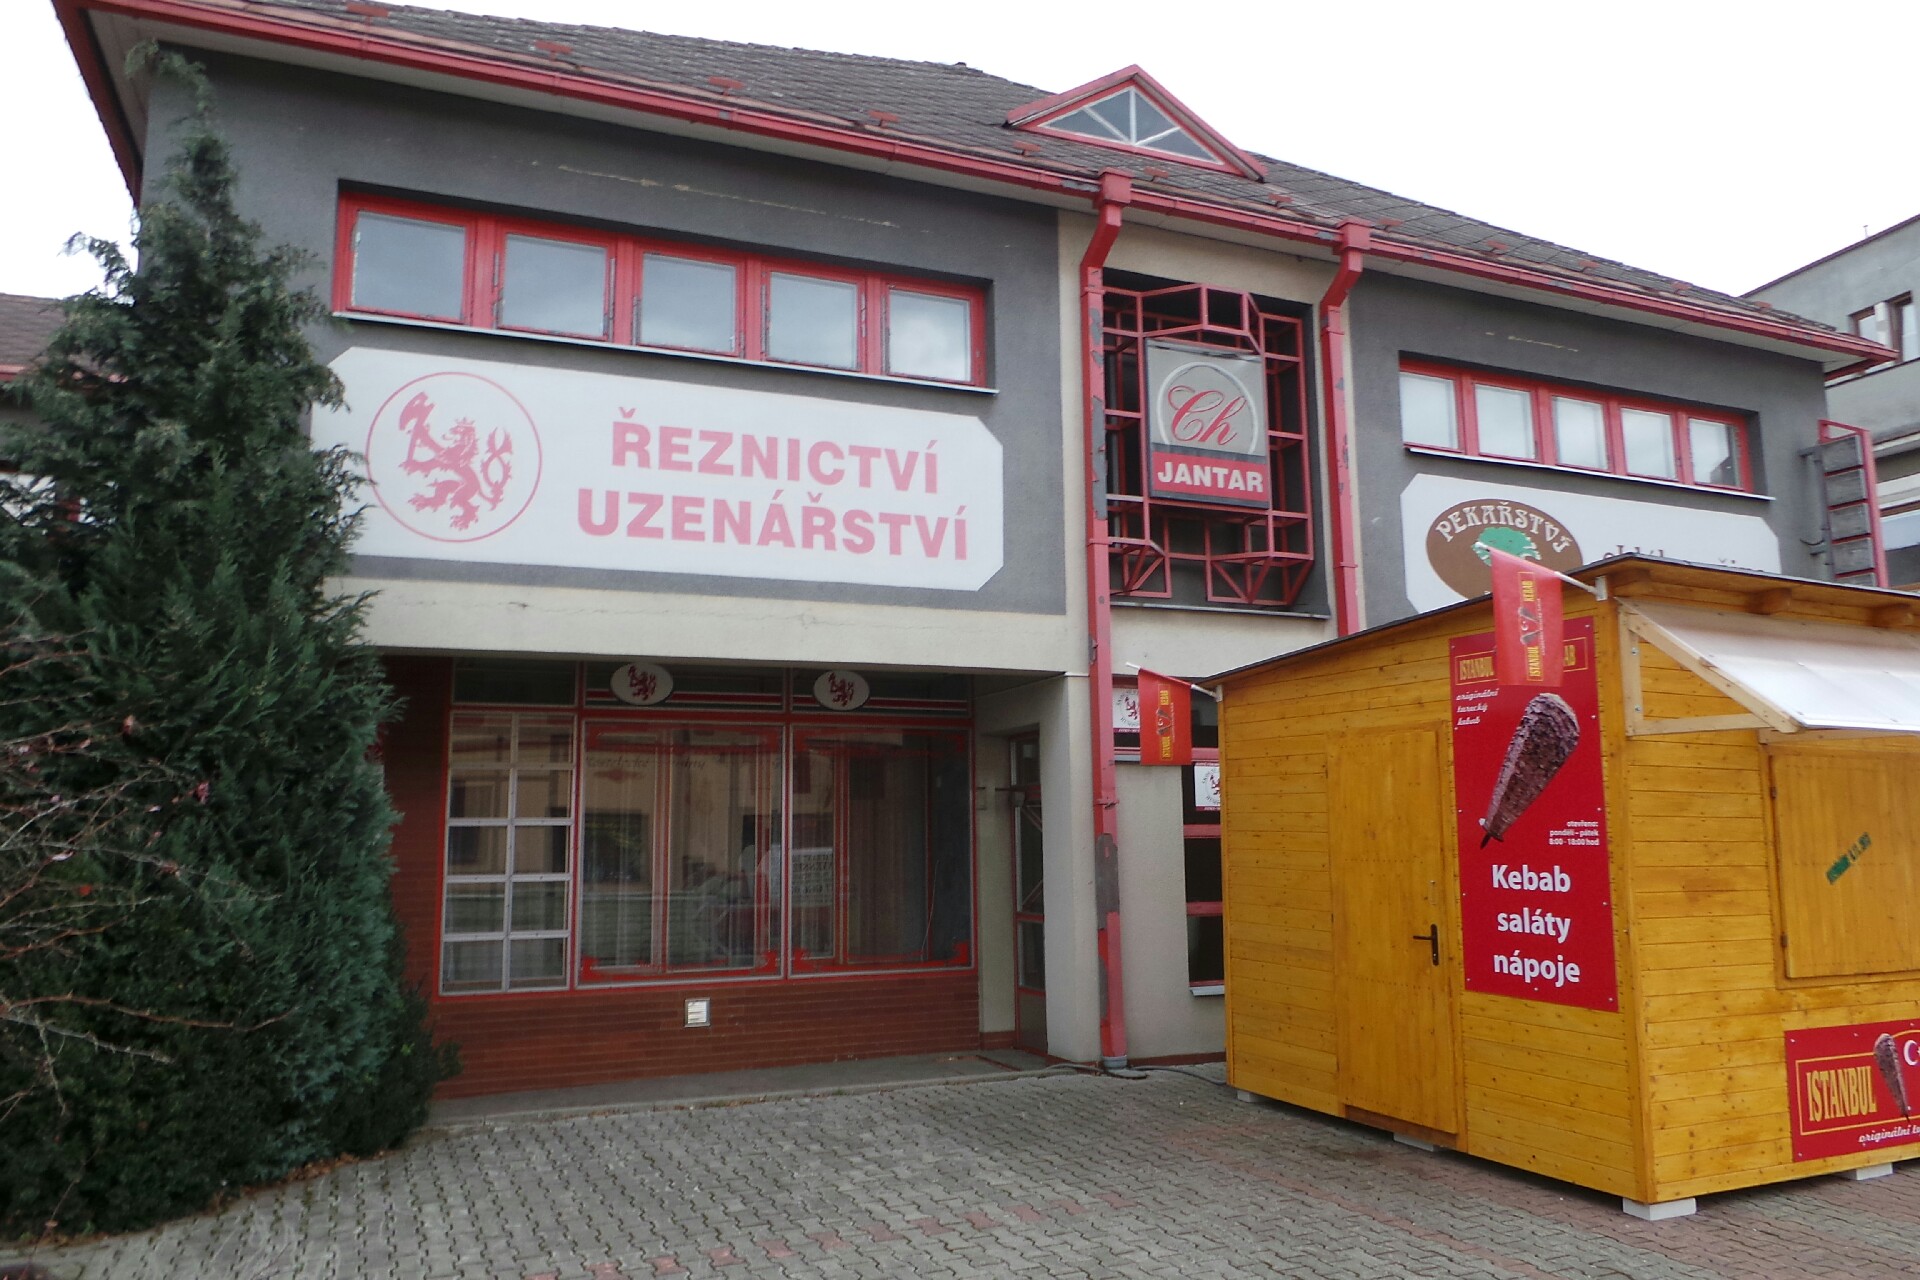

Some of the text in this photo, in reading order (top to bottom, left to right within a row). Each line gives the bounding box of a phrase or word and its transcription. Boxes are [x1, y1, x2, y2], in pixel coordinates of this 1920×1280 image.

[612, 406, 939, 494] ŘEZNICTVÍ
[1158, 461, 1264, 493] JANTAR
[577, 488, 968, 561] UZENÁŘSTVÍ
[1436, 501, 1573, 553] PEKAŘSTVÍ
[1459, 656, 1494, 680] ISTANBUL
[1492, 864, 1571, 893] Kebab
[1497, 907, 1571, 944] saláty
[1494, 950, 1581, 987] nápoje
[1806, 1066, 1877, 1122] ISTANBUL
